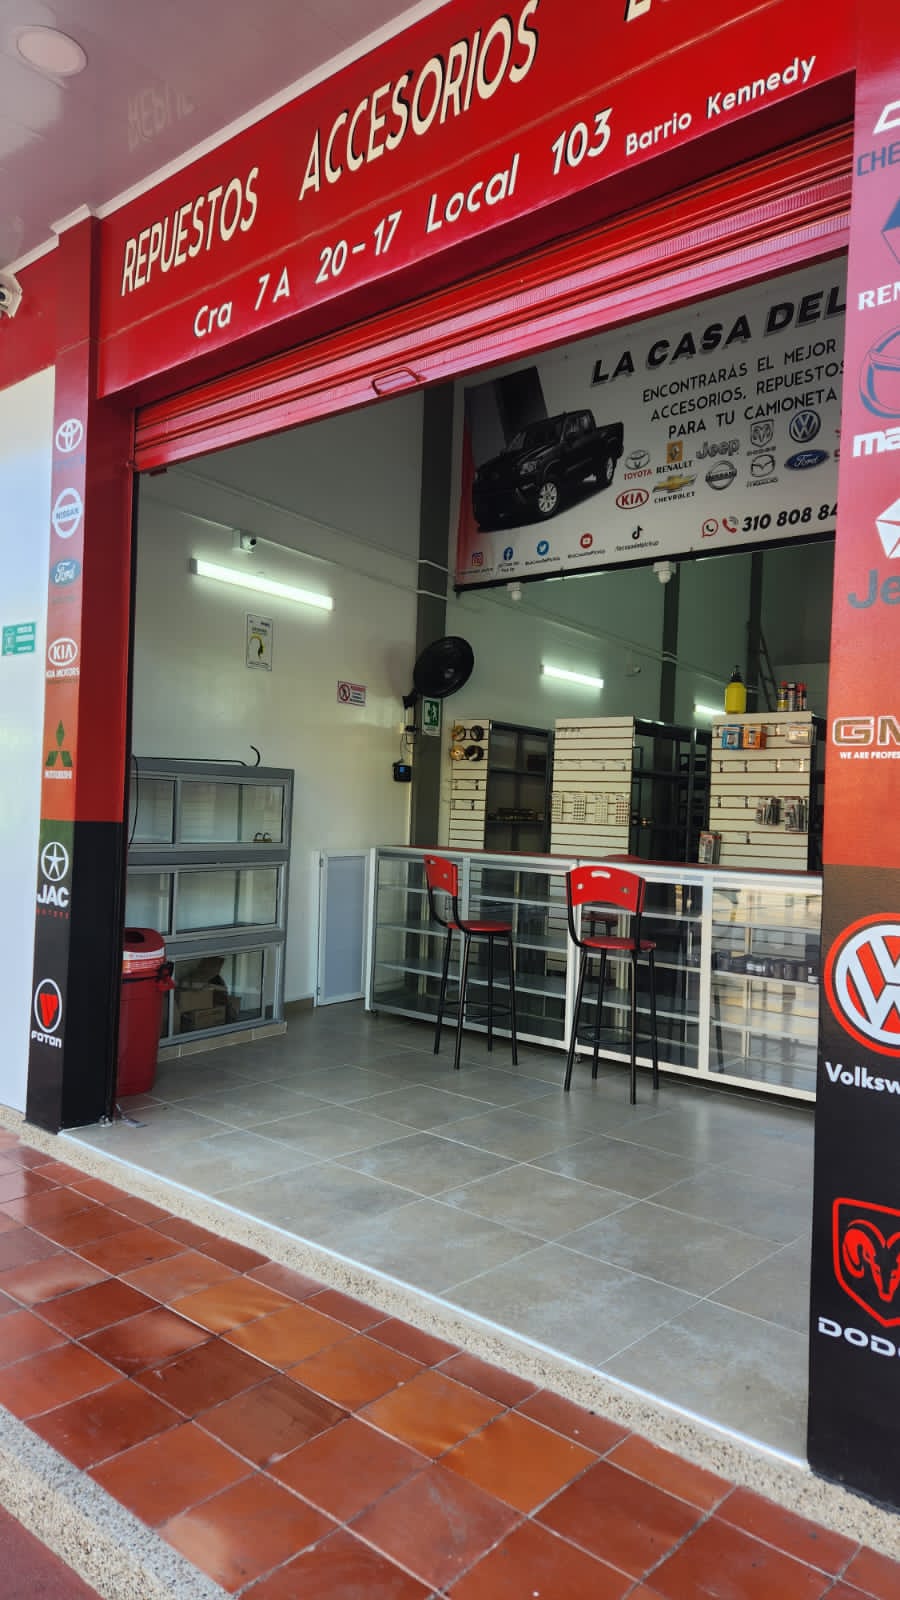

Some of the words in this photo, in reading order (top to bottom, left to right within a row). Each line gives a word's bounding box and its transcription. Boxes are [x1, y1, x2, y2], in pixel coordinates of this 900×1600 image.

[121, 167, 259, 297] REPUESTOS
[299, 0, 539, 201] ACCESORIOS
[193, 301, 232, 338] Cra
[426, 153, 520, 233] Local
[551, 107, 613, 176] 103
[626, 112, 692, 156] Barrio
[707, 56, 816, 119] Kennedy
[591, 351, 635, 386] LA
[646, 315, 752, 370] CASA
[765, 286, 846, 335] DEL
[757, 356, 774, 373] EL
[784, 338, 836, 365] MEJOR
[668, 418, 706, 439] PARA
[716, 411, 735, 427] TU
[744, 387, 837, 421] CAMIONETA
[656, 461, 693, 474] RENAULT
[696, 440, 739, 460] Jeep
[624, 469, 653, 480] TOYOTA
[620, 491, 645, 506] KIA
[742, 514, 772, 532] 310
[776, 507, 812, 527] 808
[54, 561, 76, 583] Ford
[53, 644, 73, 660] KIA
[840, 751, 852, 760] WE
[37, 884, 69, 908] JAC
